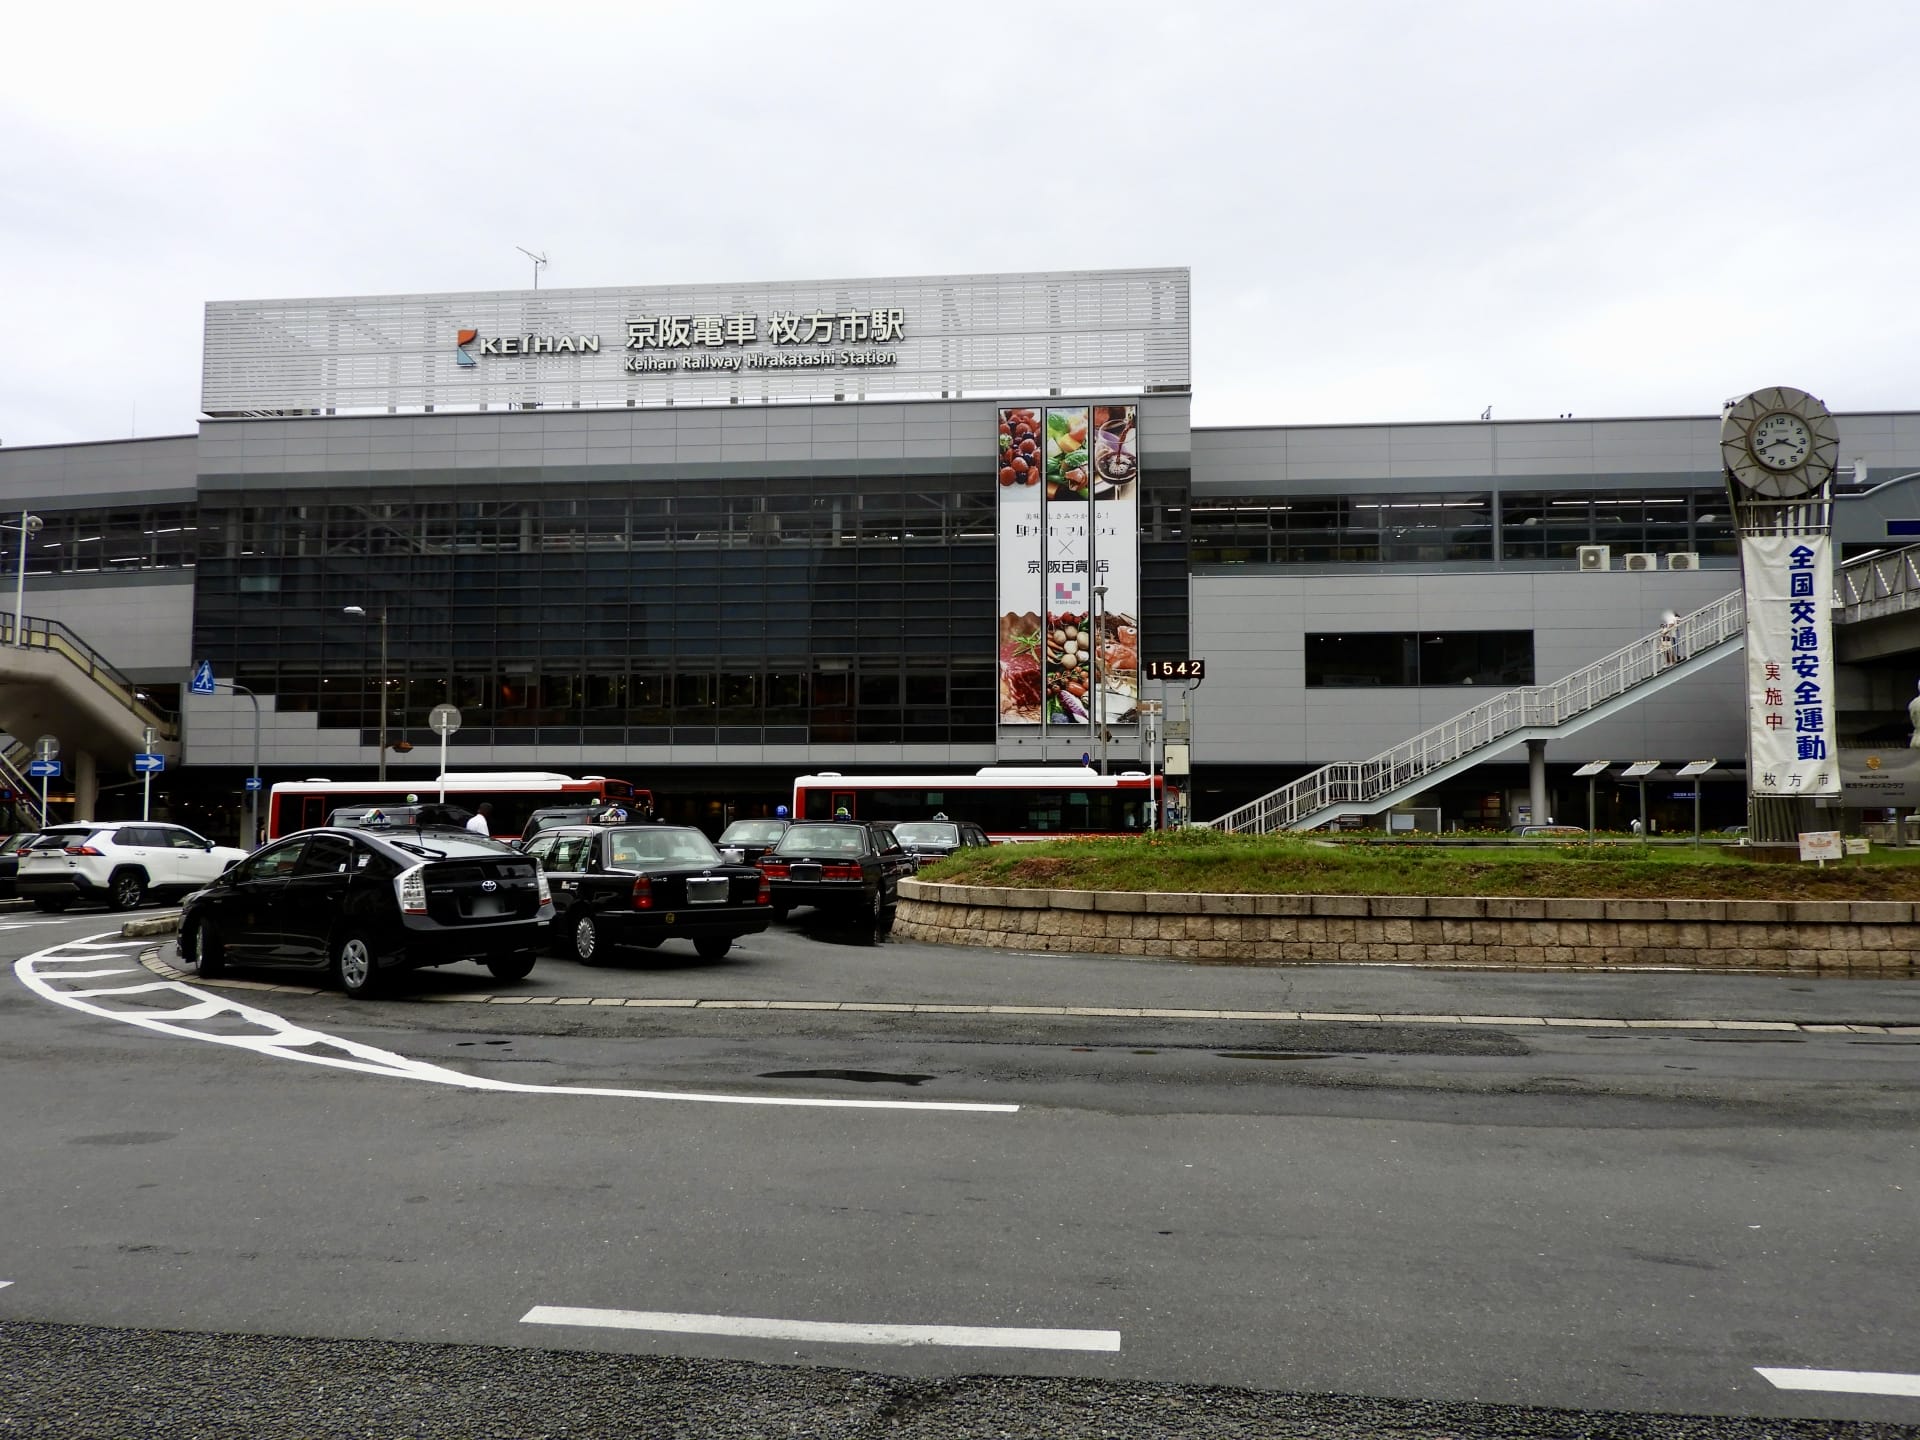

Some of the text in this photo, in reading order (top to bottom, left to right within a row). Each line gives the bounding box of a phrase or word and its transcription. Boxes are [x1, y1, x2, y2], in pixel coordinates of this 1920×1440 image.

[625, 308, 905, 349] 京阪電車 枚方市駅
[480, 333, 599, 354] KEIHAN
[624, 350, 897, 371] Keihan Railway Hirakatashi Station
[1027, 560, 1109, 573] 京阪百貨店
[1789, 545, 1826, 760] 全国交通安全運動
[1151, 661, 1201, 675] 1542
[1765, 662, 1783, 731] 実施中
[1763, 772, 1829, 787] 枚方市
